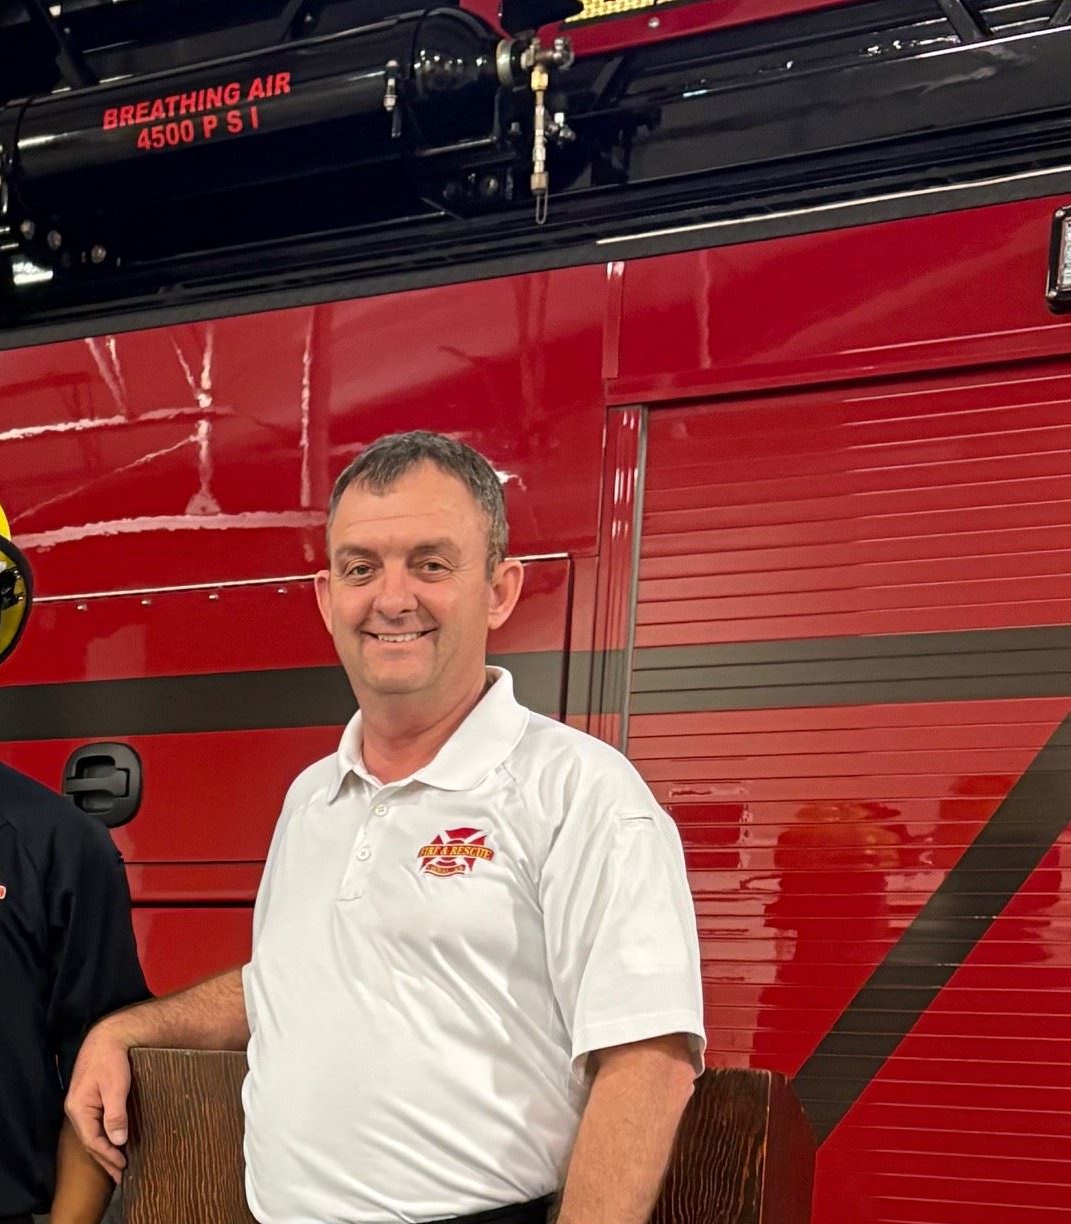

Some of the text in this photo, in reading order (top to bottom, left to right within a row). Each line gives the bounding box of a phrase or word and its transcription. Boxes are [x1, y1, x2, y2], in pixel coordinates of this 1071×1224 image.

[103, 72, 291, 130] BREATHING AIR
[137, 106, 259, 149] 4500 P S I
[421, 846, 440, 857] FIRE
[449, 846, 491, 858] RESCUE
